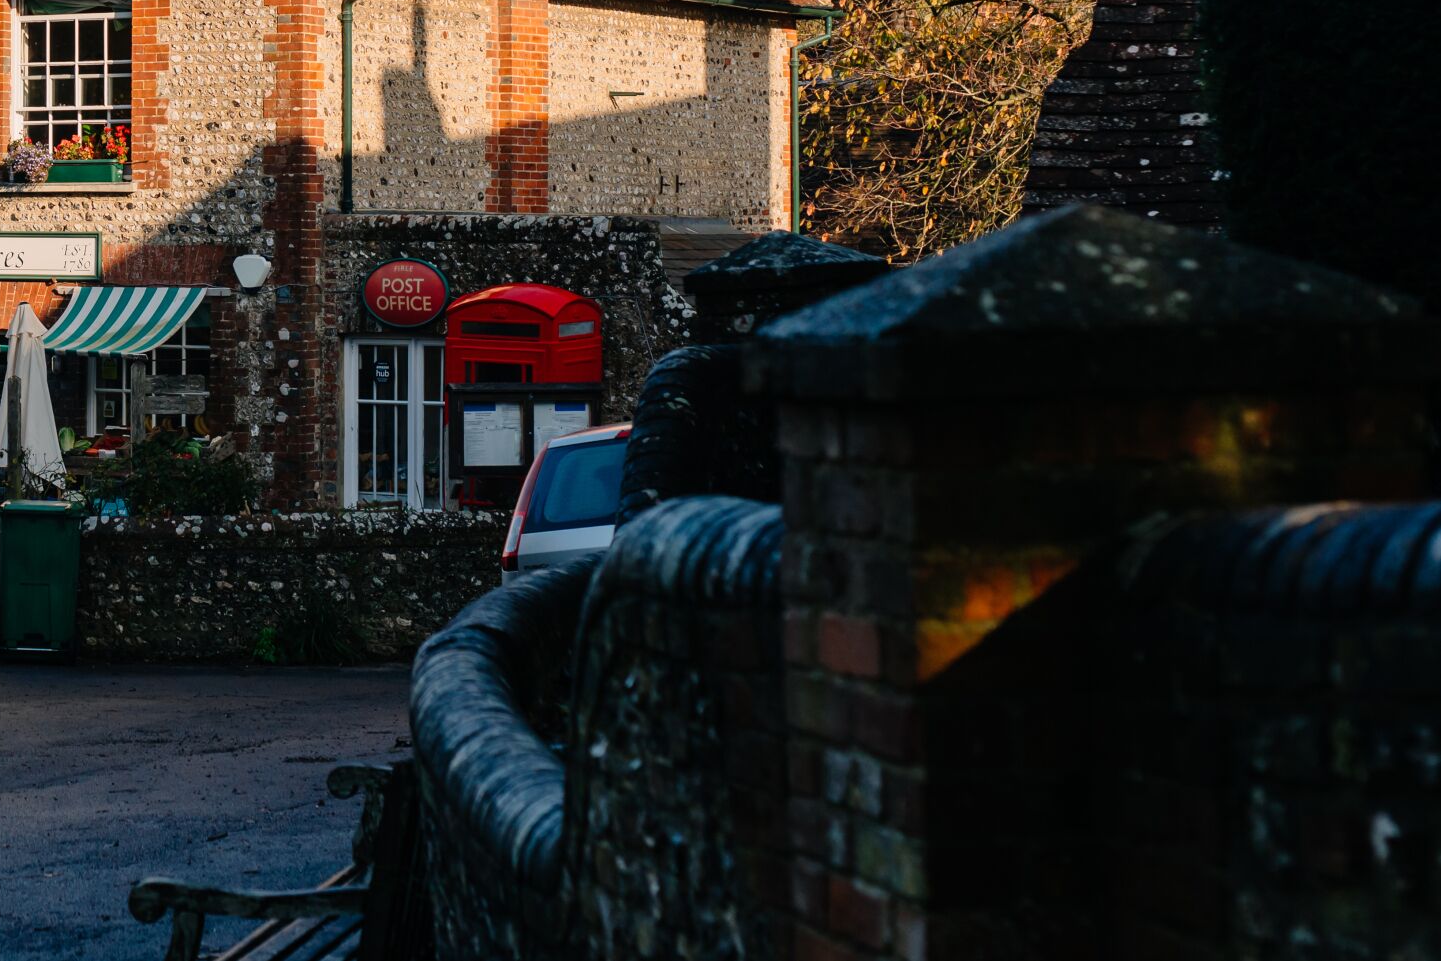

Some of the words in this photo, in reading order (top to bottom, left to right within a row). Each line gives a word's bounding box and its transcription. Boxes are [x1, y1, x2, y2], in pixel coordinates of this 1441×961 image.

[63, 257, 91, 272] 1780
[382, 278, 424, 293] POST
[376, 295, 431, 311] OFFICE
[375, 369, 390, 377] hub
